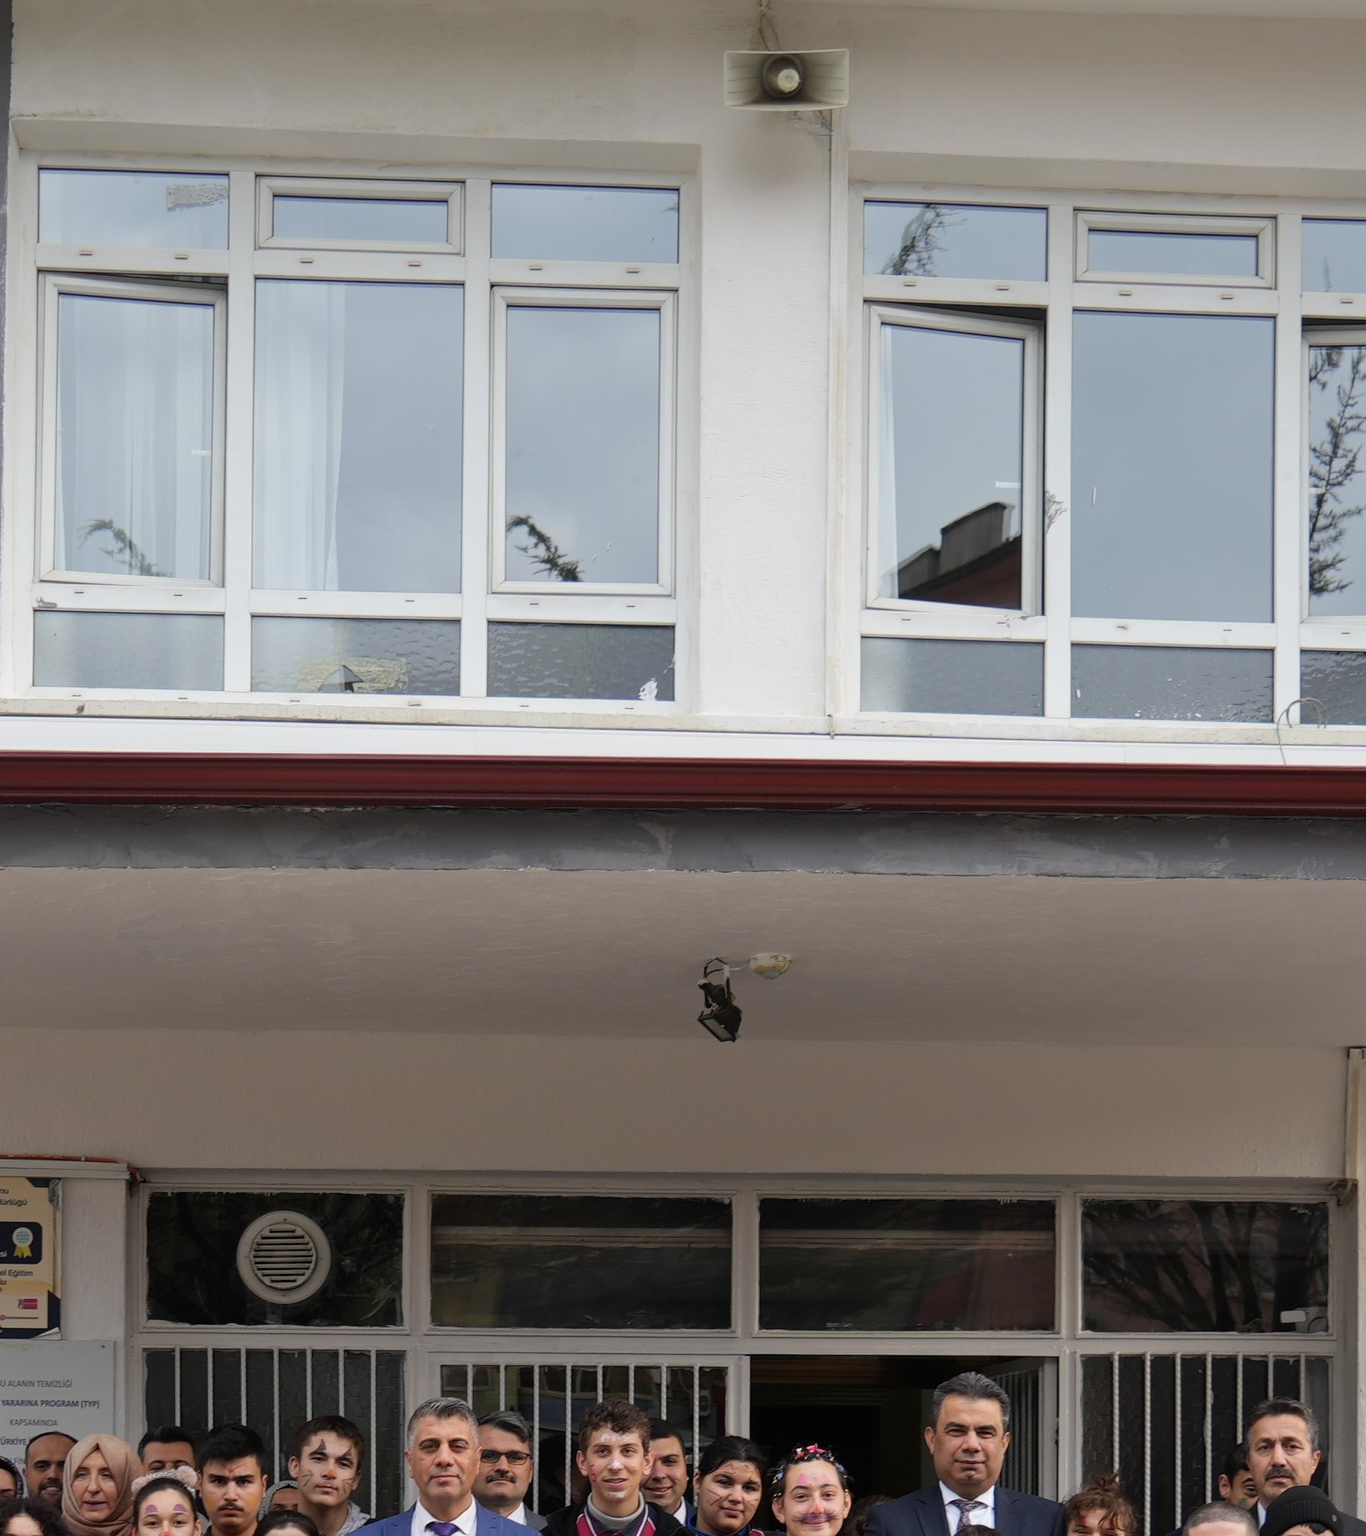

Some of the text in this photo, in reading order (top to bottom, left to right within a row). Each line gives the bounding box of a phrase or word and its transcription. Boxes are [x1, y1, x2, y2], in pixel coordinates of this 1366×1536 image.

[8, 1269, 33, 1278] Eğitim
[8, 1379, 35, 1387] ALANIN
[37, 1379, 73, 1388] TEMİZLİĞİ
[1, 1399, 39, 1407] YARARINA
[40, 1400, 79, 1408] PROGRAM
[80, 1400, 100, 1409] (TYP)
